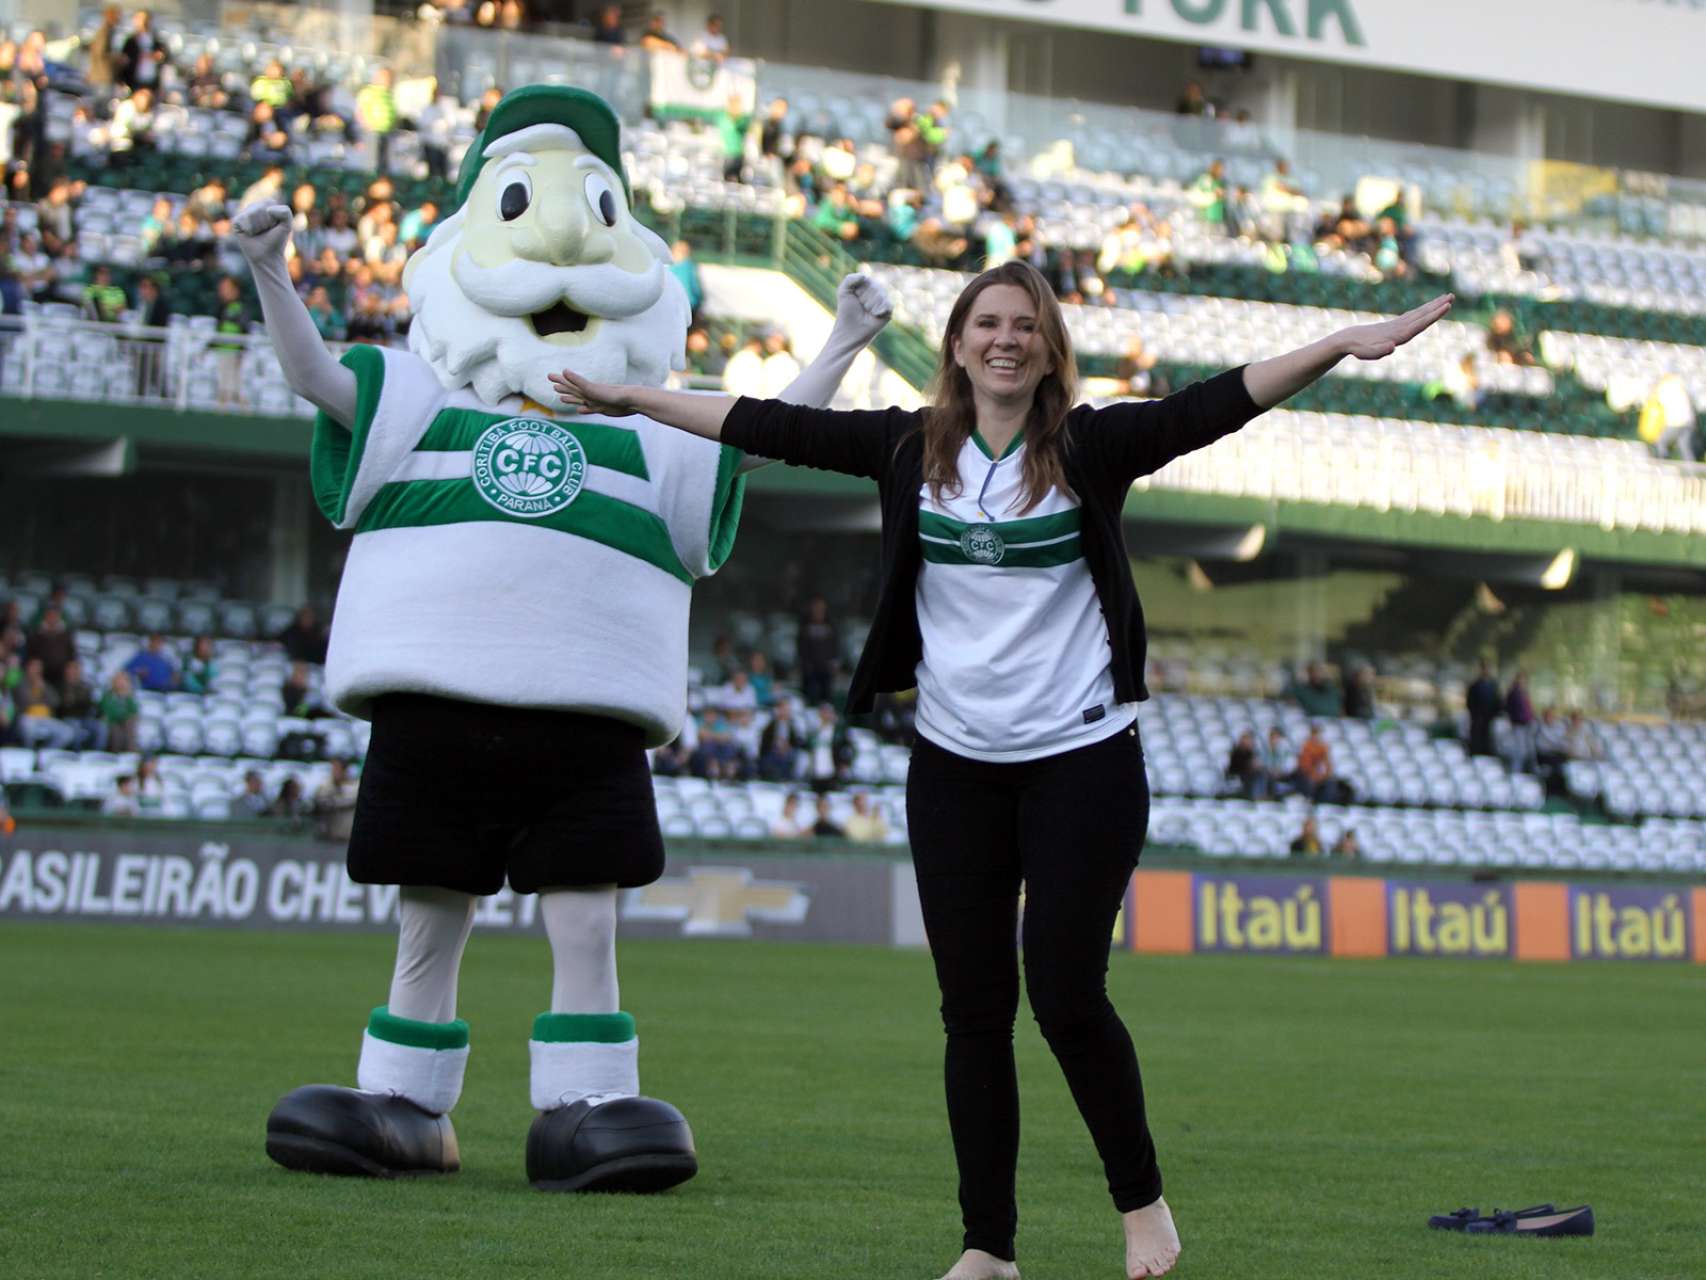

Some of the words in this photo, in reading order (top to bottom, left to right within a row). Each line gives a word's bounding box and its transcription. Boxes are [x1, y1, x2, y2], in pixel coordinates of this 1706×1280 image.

[476, 426, 508, 488] CORITIBA
[562, 461, 583, 496] CLUB
[496, 448, 562, 479] CFC
[970, 540, 995, 552] CFC
[0, 841, 260, 920] ASILEIRÃO
[1202, 880, 1322, 949] Itaú
[1393, 888, 1508, 953] Itaú
[1576, 892, 1686, 957] Itaú
